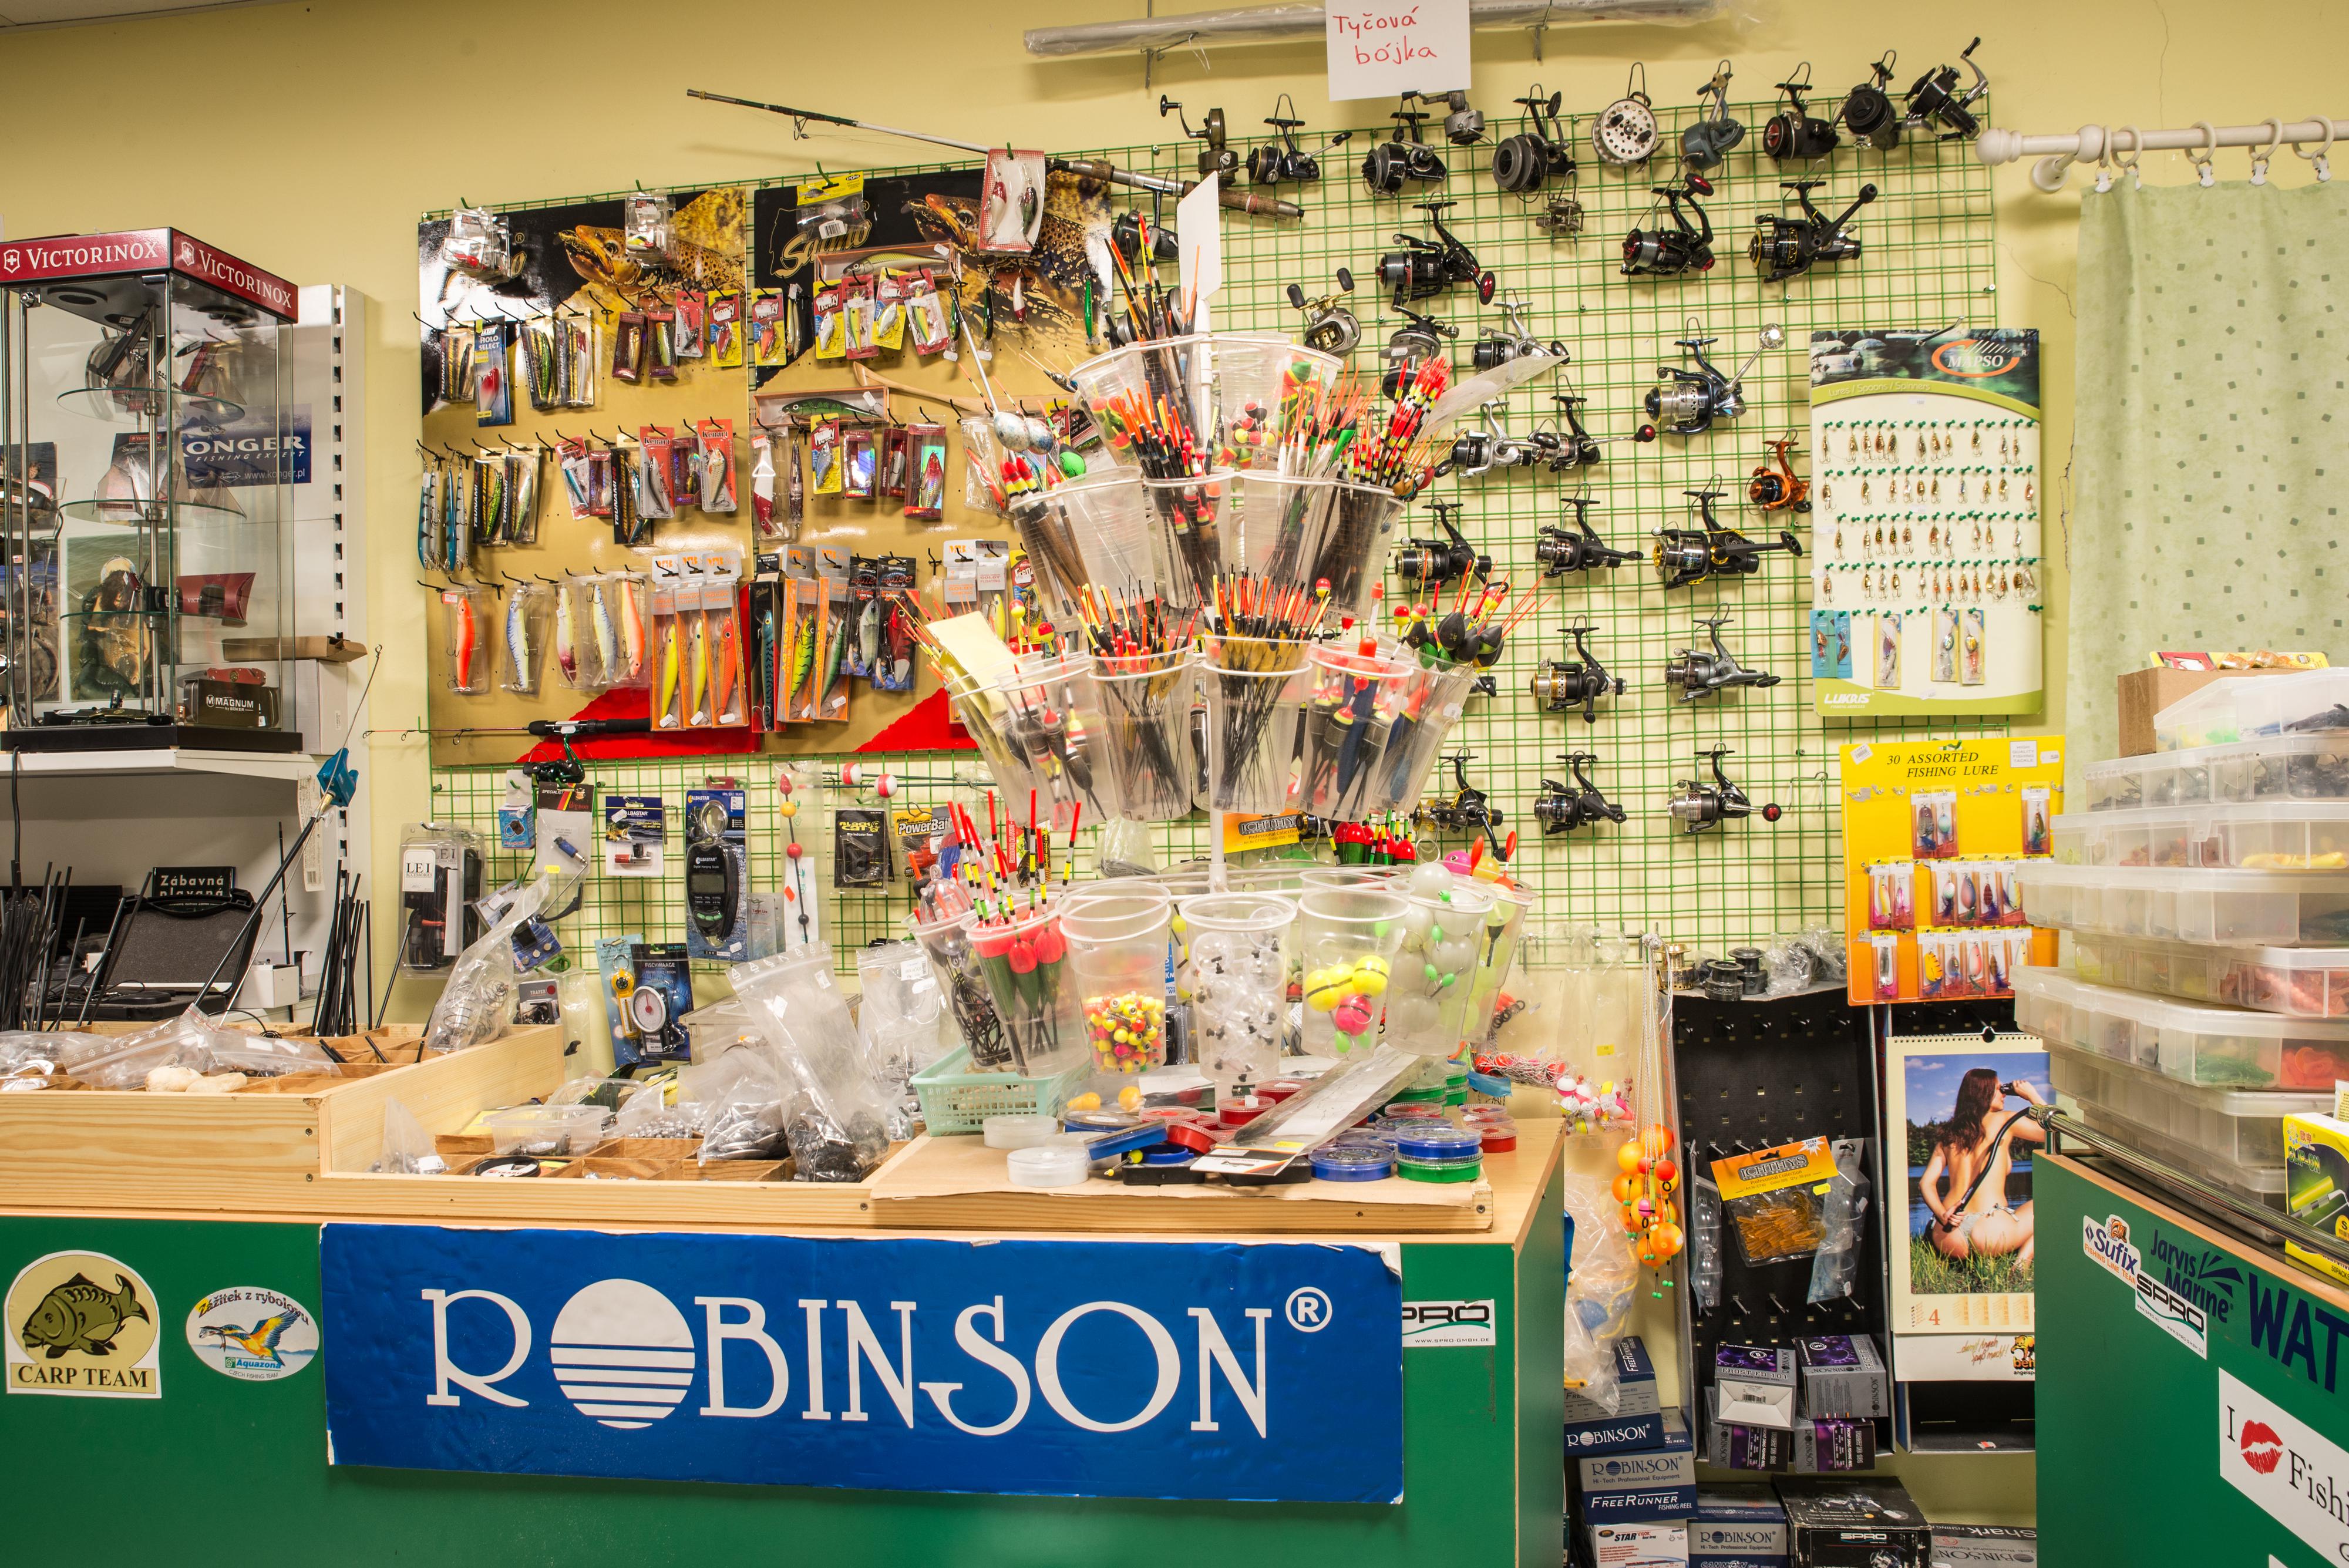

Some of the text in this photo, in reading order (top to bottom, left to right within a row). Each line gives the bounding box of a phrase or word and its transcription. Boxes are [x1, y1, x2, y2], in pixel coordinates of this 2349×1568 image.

[1333, 6, 1419, 39] Tyčová
[1355, 36, 1437, 65] bójka
[26, 240, 159, 270] VICTORINOX
[199, 250, 292, 309] VICTORINOX
[478, 342, 500, 351] SELECT
[1947, 354, 2004, 369] MAPSO
[1828, 382, 1930, 396] Lures Spoons Spinners
[644, 437, 670, 445] Kenart
[196, 453, 250, 462] FISHING
[215, 697, 254, 709] MAGNUM
[1886, 752, 1979, 765] 30 ASSORTED
[1906, 765, 1999, 778] FISHING LURE
[1241, 817, 1297, 834] ICHTHY
[1248, 832, 1276, 840] Professional
[406, 863, 431, 873] LEI
[160, 874, 224, 886] Zábavná
[1741, 1155, 1806, 1178] ICHTHYS
[2287, 1145, 2321, 1174] CLIP-ON
[1750, 1169, 1803, 1185] Professional Collection
[2085, 1243, 2105, 1264] FISHING
[2106, 1258, 2120, 1274] LINE
[2094, 1228, 2138, 1276] Sufix
[2151, 1229, 2197, 1278] Jarvis
[2136, 1273, 2205, 1333] SPRO
[2163, 1266, 2229, 1324] Marine
[198, 1290, 309, 1326] Zážitek z rybolovu
[1402, 1305, 1490, 1324] PRO
[1929, 1308, 1940, 1326] 4
[236, 1358, 281, 1369] Aquazona
[422, 1278, 1273, 1438] ROBINSON
[18, 1364, 149, 1388] CARP TEAM
[228, 1369, 245, 1378] CZECH
[1871, 1379, 1881, 1418] ROBINSON
[1566, 1425, 1647, 1447] ROBINSON
[1805, 1429, 1813, 1468] ROBINSON
[1591, 1458, 1681, 1476] ROBINSON
[2226, 1405, 2349, 1527] I Fish
[1652, 1473, 1680, 1482] Equipment
[1675, 1502, 1693, 1510] REEL
[1614, 1532, 1638, 1542] STAR
[1700, 1530, 1773, 1544] ROBINSON
[1840, 1532, 1887, 1541] SPRO
